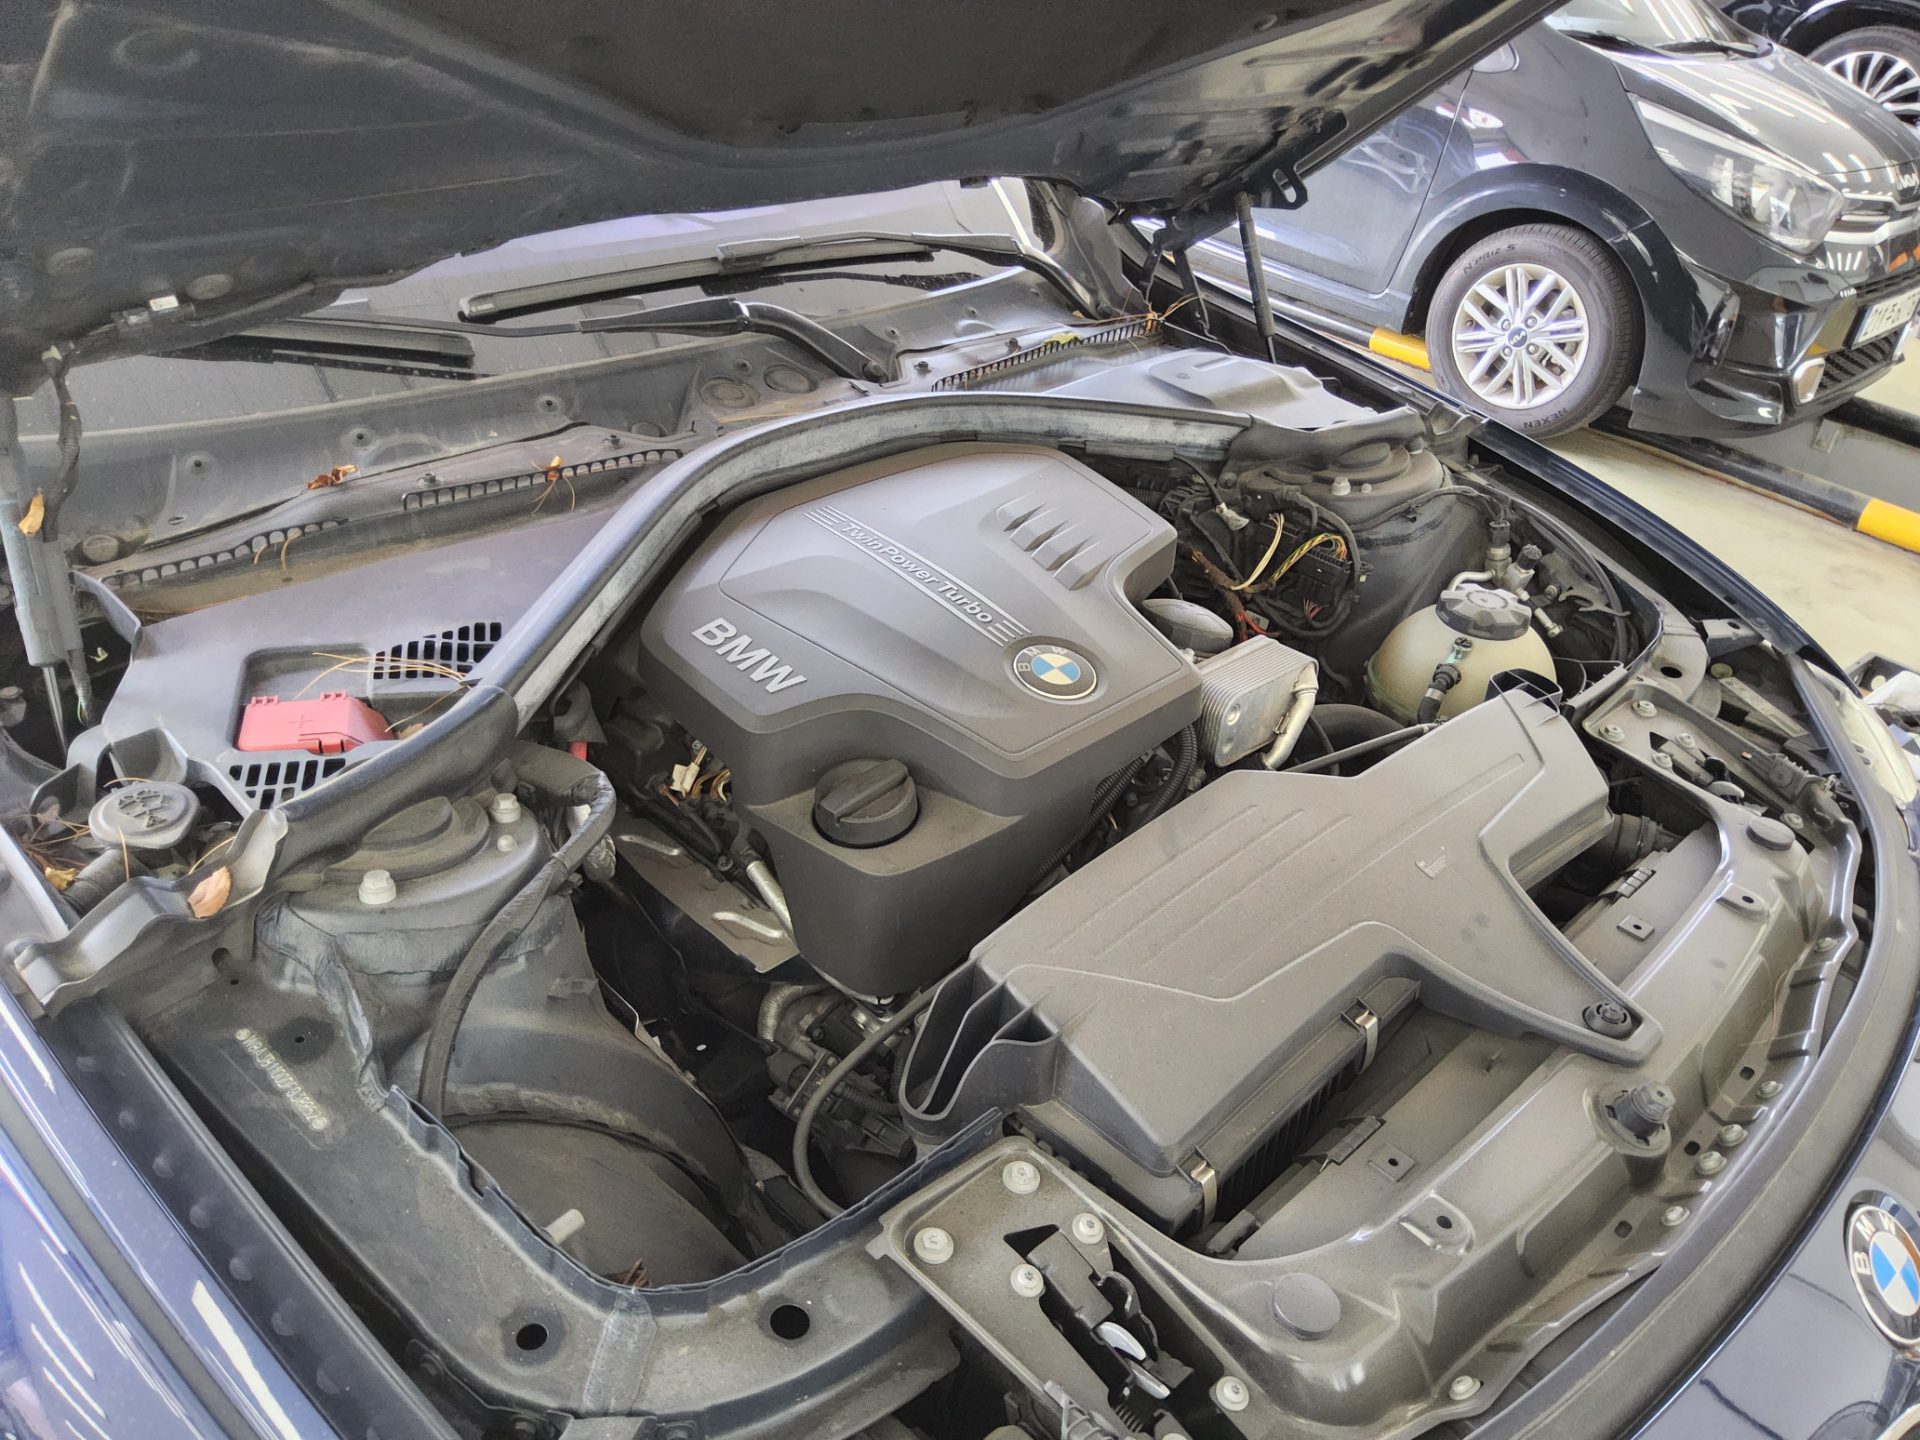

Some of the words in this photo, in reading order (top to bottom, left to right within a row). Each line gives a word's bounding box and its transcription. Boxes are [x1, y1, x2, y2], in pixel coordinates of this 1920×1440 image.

[1523, 407, 1568, 429] NEXEN
[937, 580, 993, 624] Turbo
[692, 617, 807, 693] BMW
[1018, 646, 1070, 671] BMW
[1854, 1212, 1896, 1275] BMW
